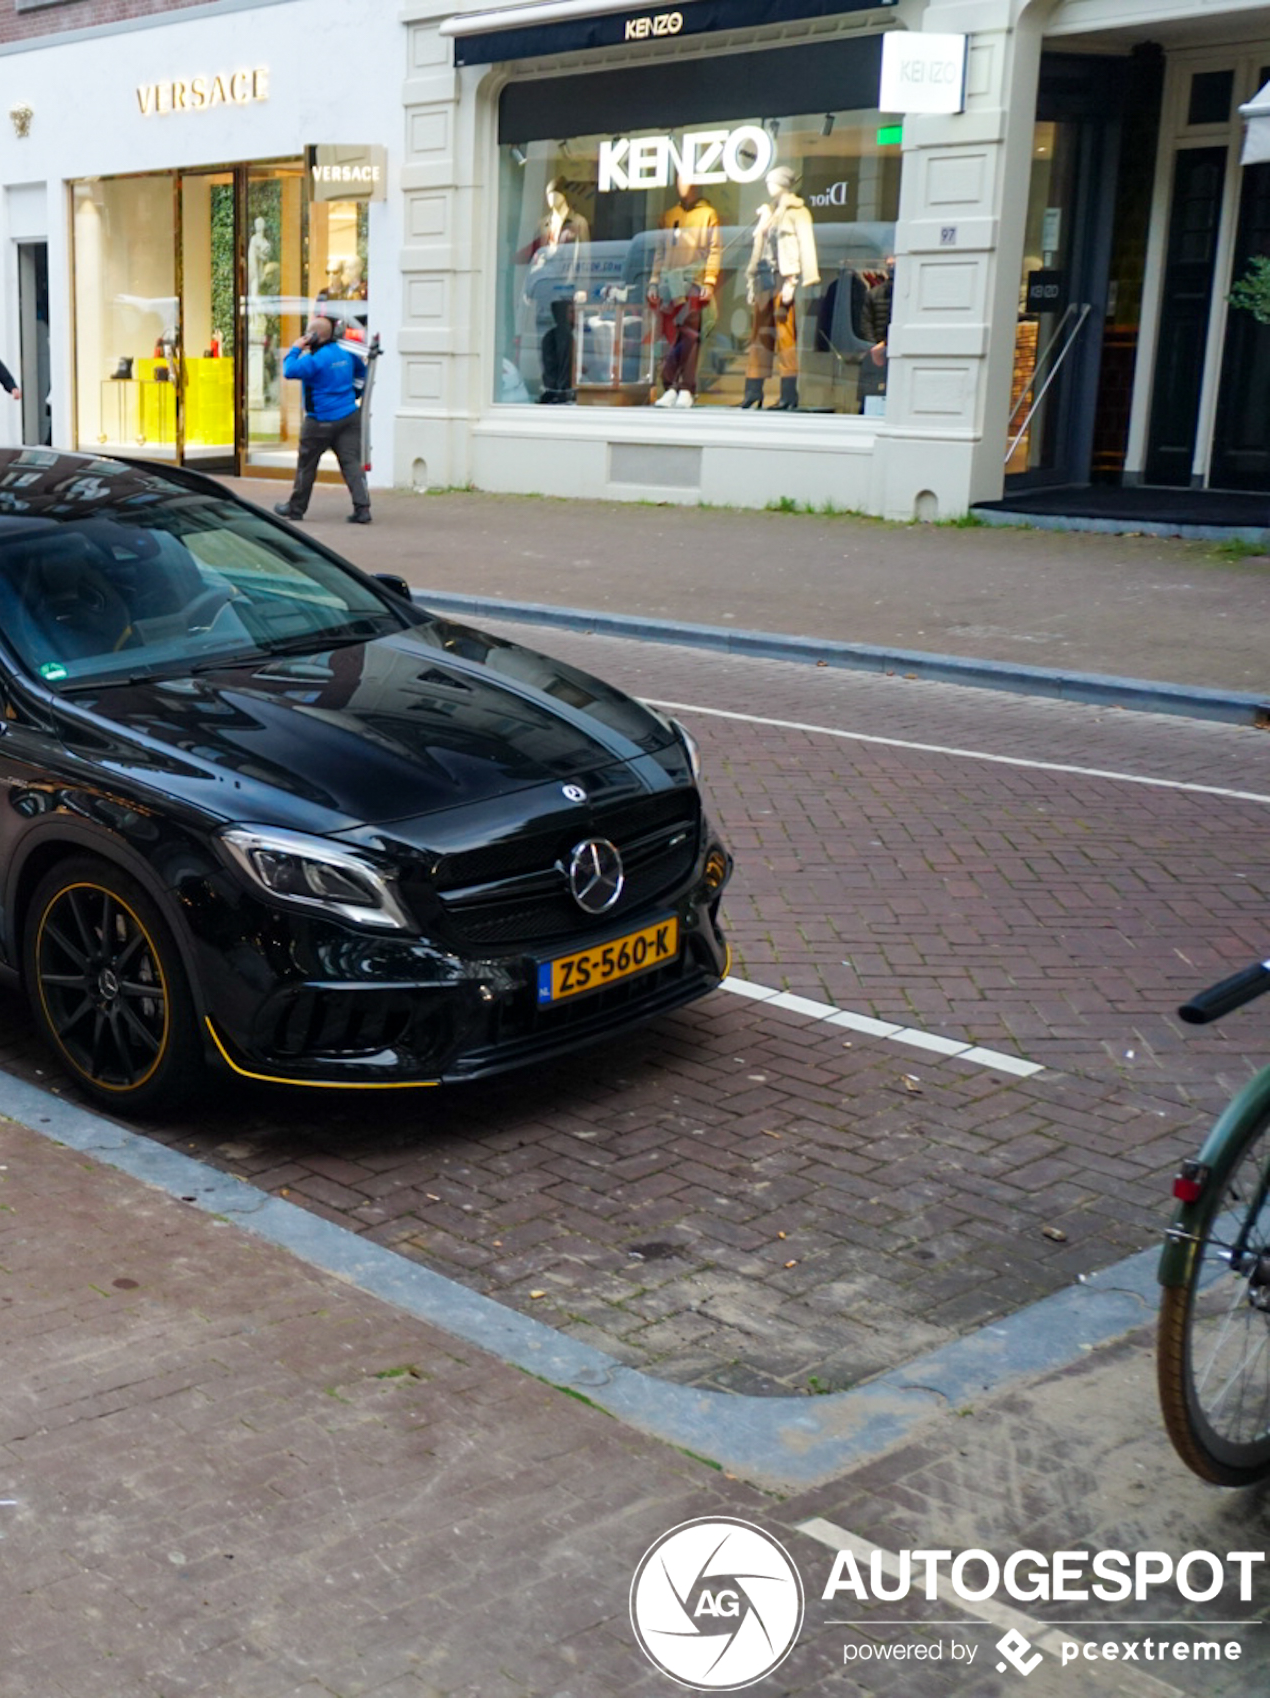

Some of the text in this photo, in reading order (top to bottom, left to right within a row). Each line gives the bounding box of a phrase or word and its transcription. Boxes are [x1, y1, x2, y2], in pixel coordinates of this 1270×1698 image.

[624, 11, 682, 40] KENZO
[899, 60, 957, 84] KENZO
[136, 68, 268, 115] VERSACE
[311, 165, 380, 182] VERSACE
[598, 125, 772, 193] KENZO
[941, 227, 956, 242] 97
[559, 926, 669, 992] ZS-560-K
